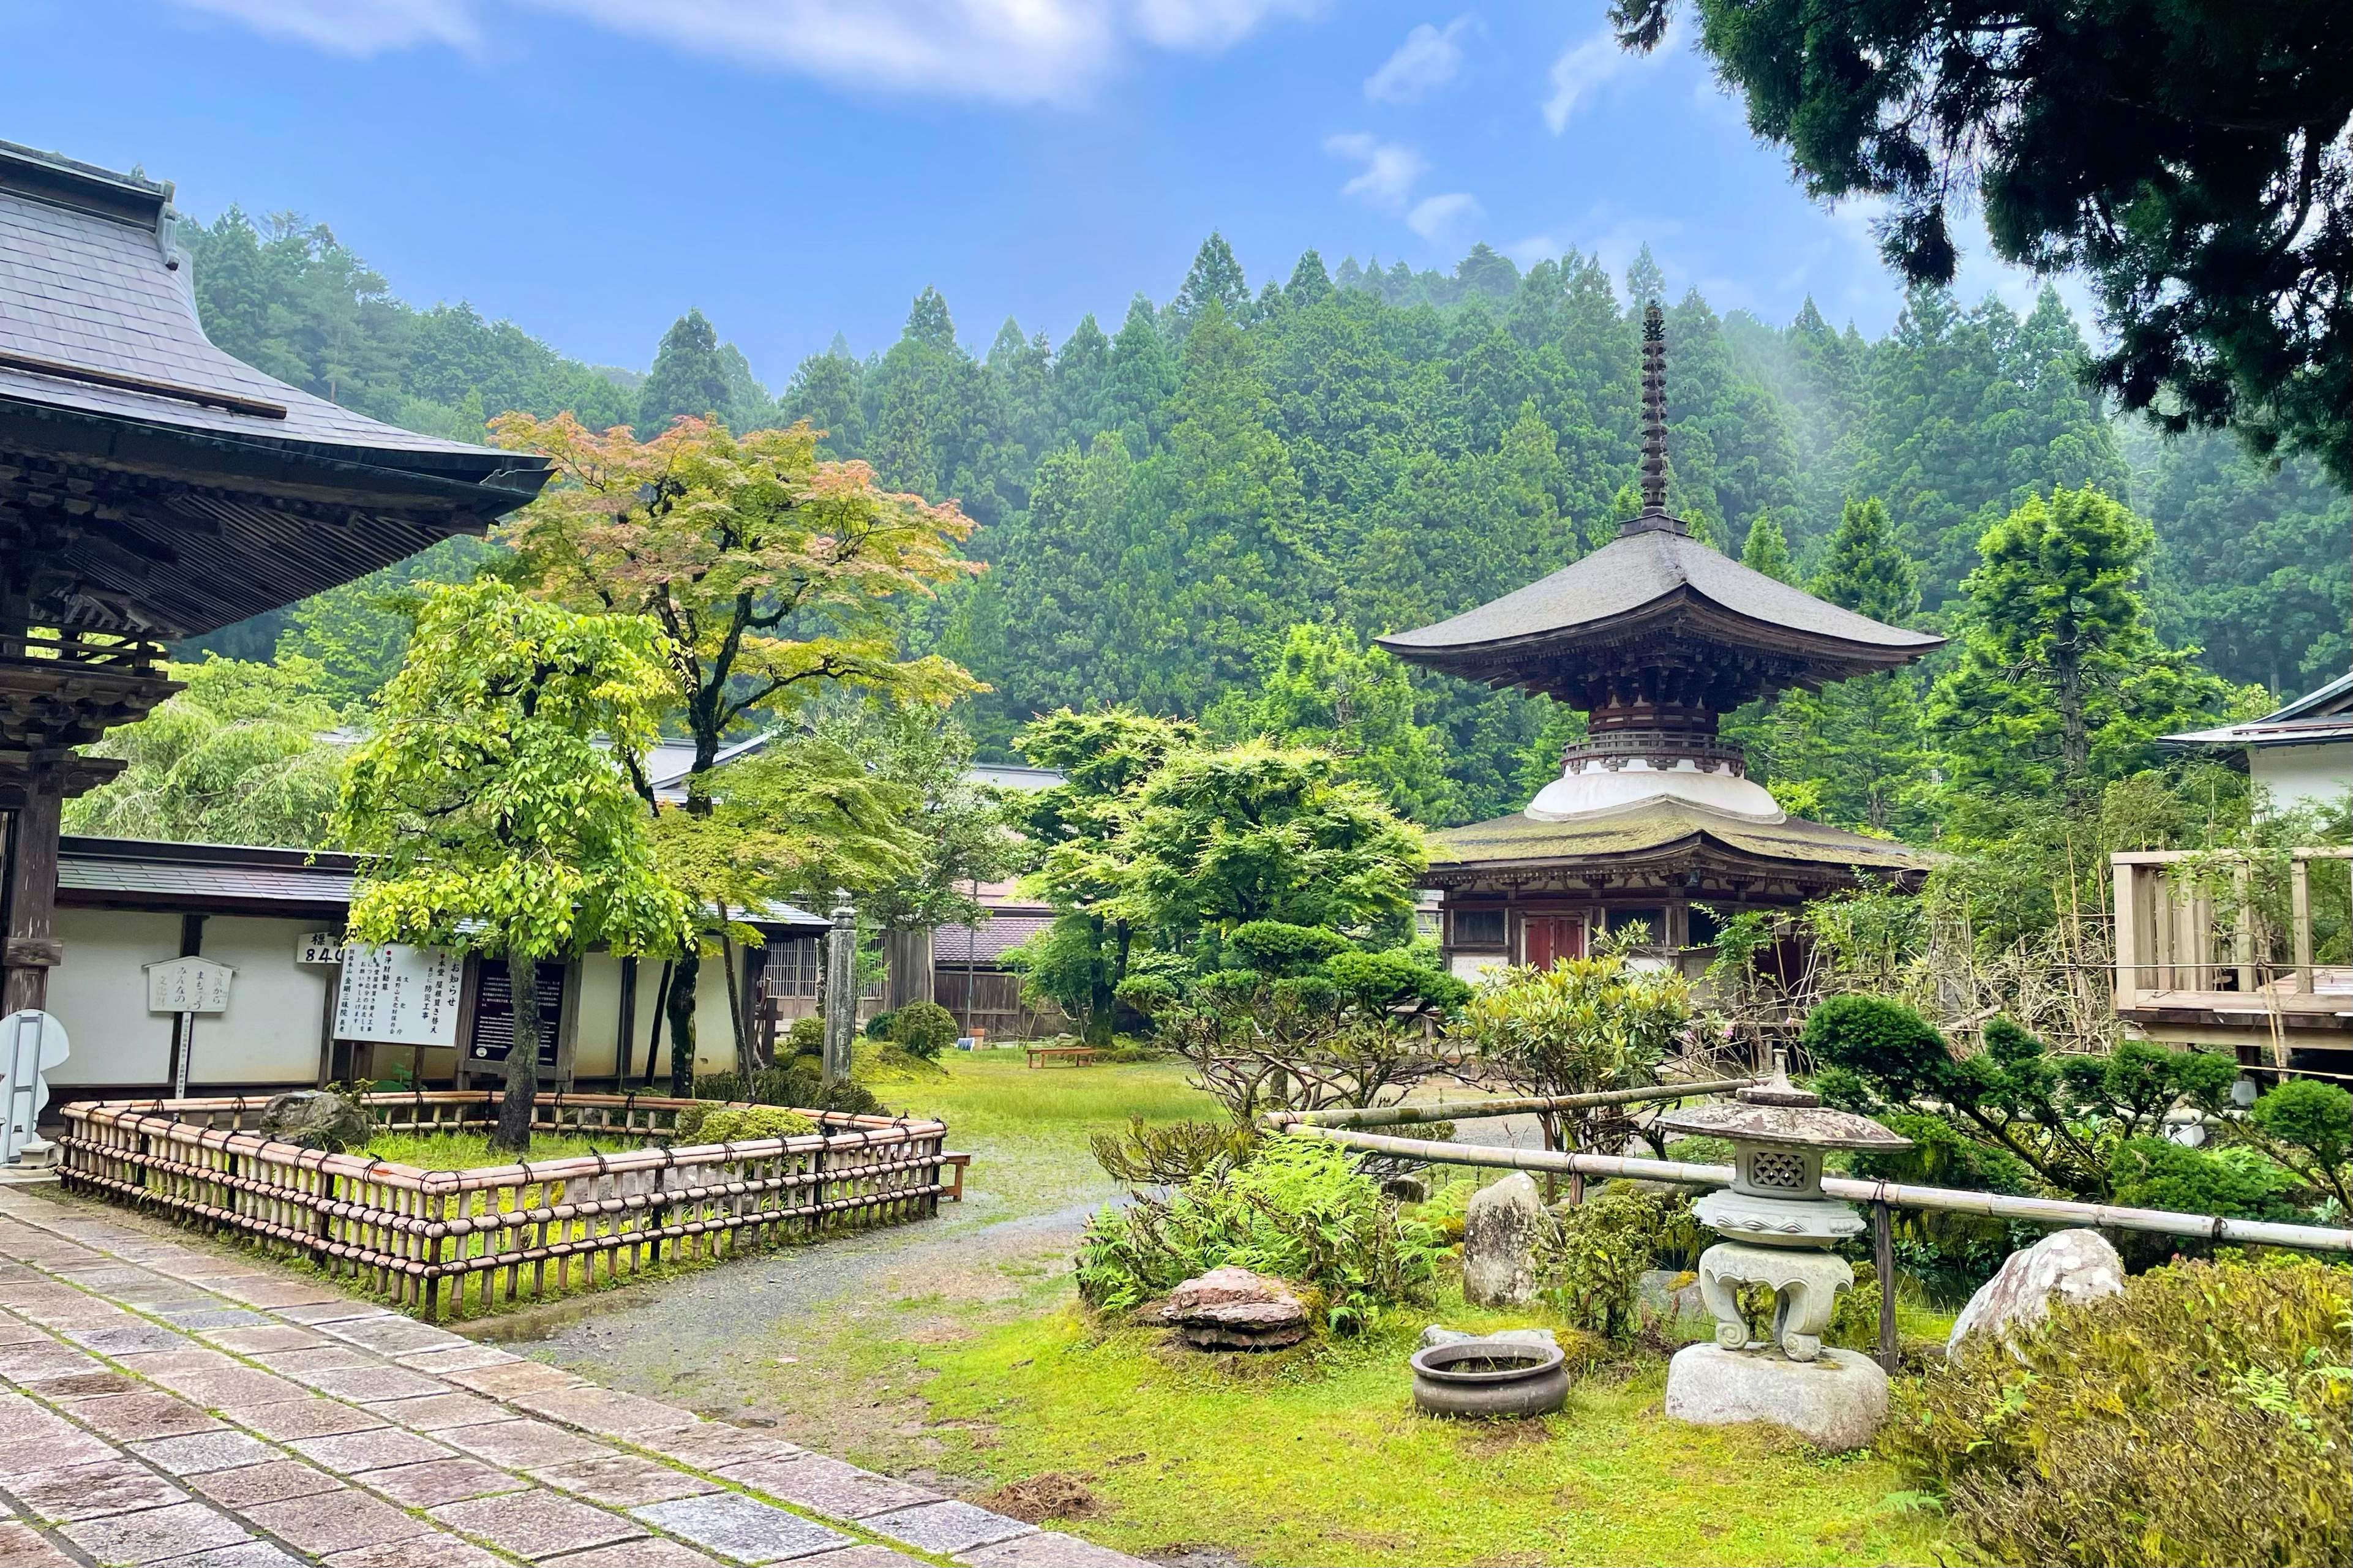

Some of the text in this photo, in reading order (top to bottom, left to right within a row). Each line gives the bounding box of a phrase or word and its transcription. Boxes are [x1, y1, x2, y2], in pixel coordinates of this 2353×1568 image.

[175, 967, 187, 1002] みんなの
[447, 963, 460, 1007] お知らせ
